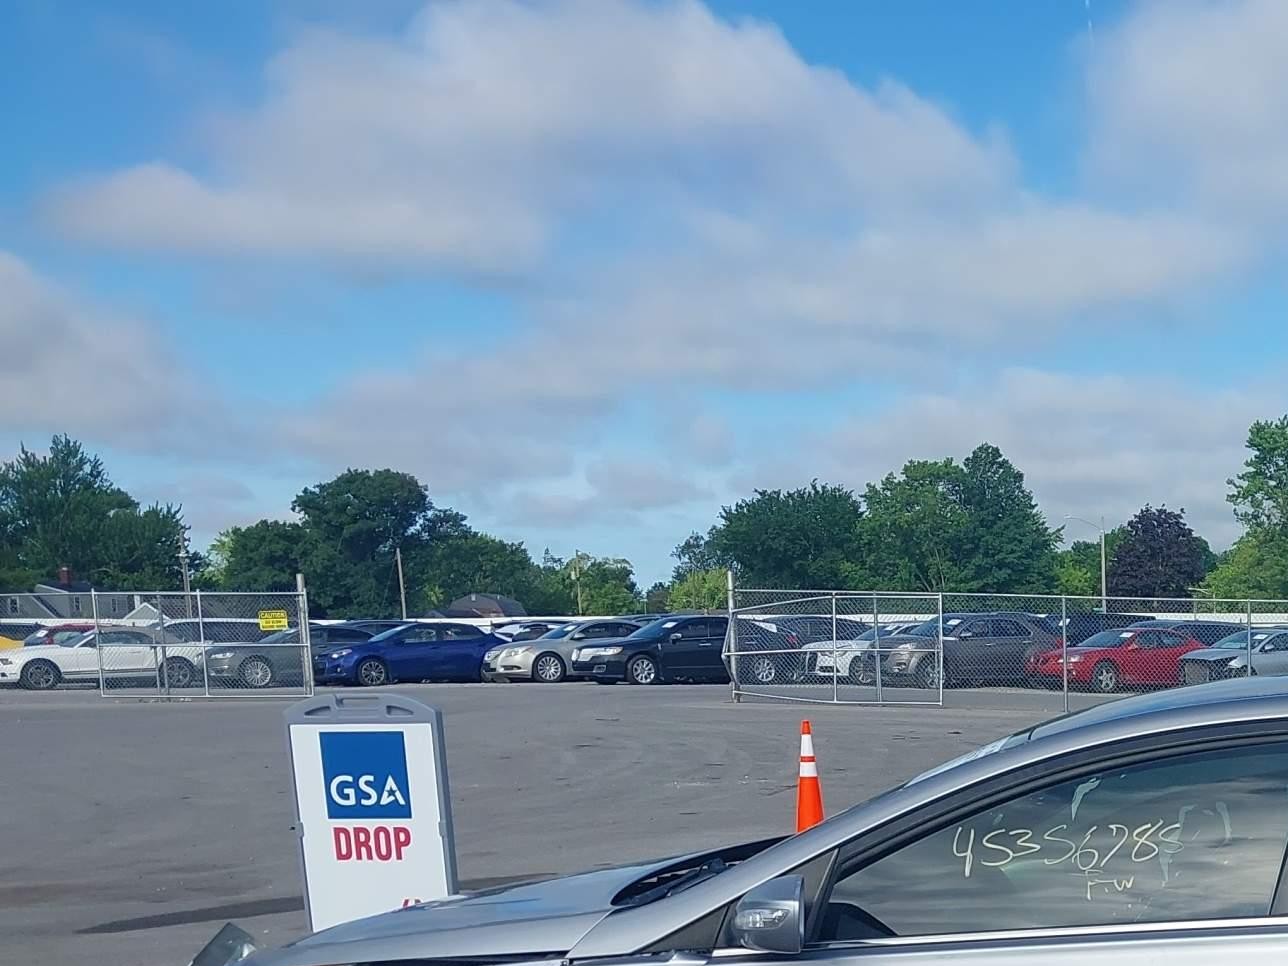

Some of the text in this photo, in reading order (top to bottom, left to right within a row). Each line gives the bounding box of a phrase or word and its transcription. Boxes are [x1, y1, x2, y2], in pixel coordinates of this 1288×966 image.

[330, 774, 405, 806] GSA
[333, 826, 411, 860] DROP
[952, 818, 1184, 878] 45356785
